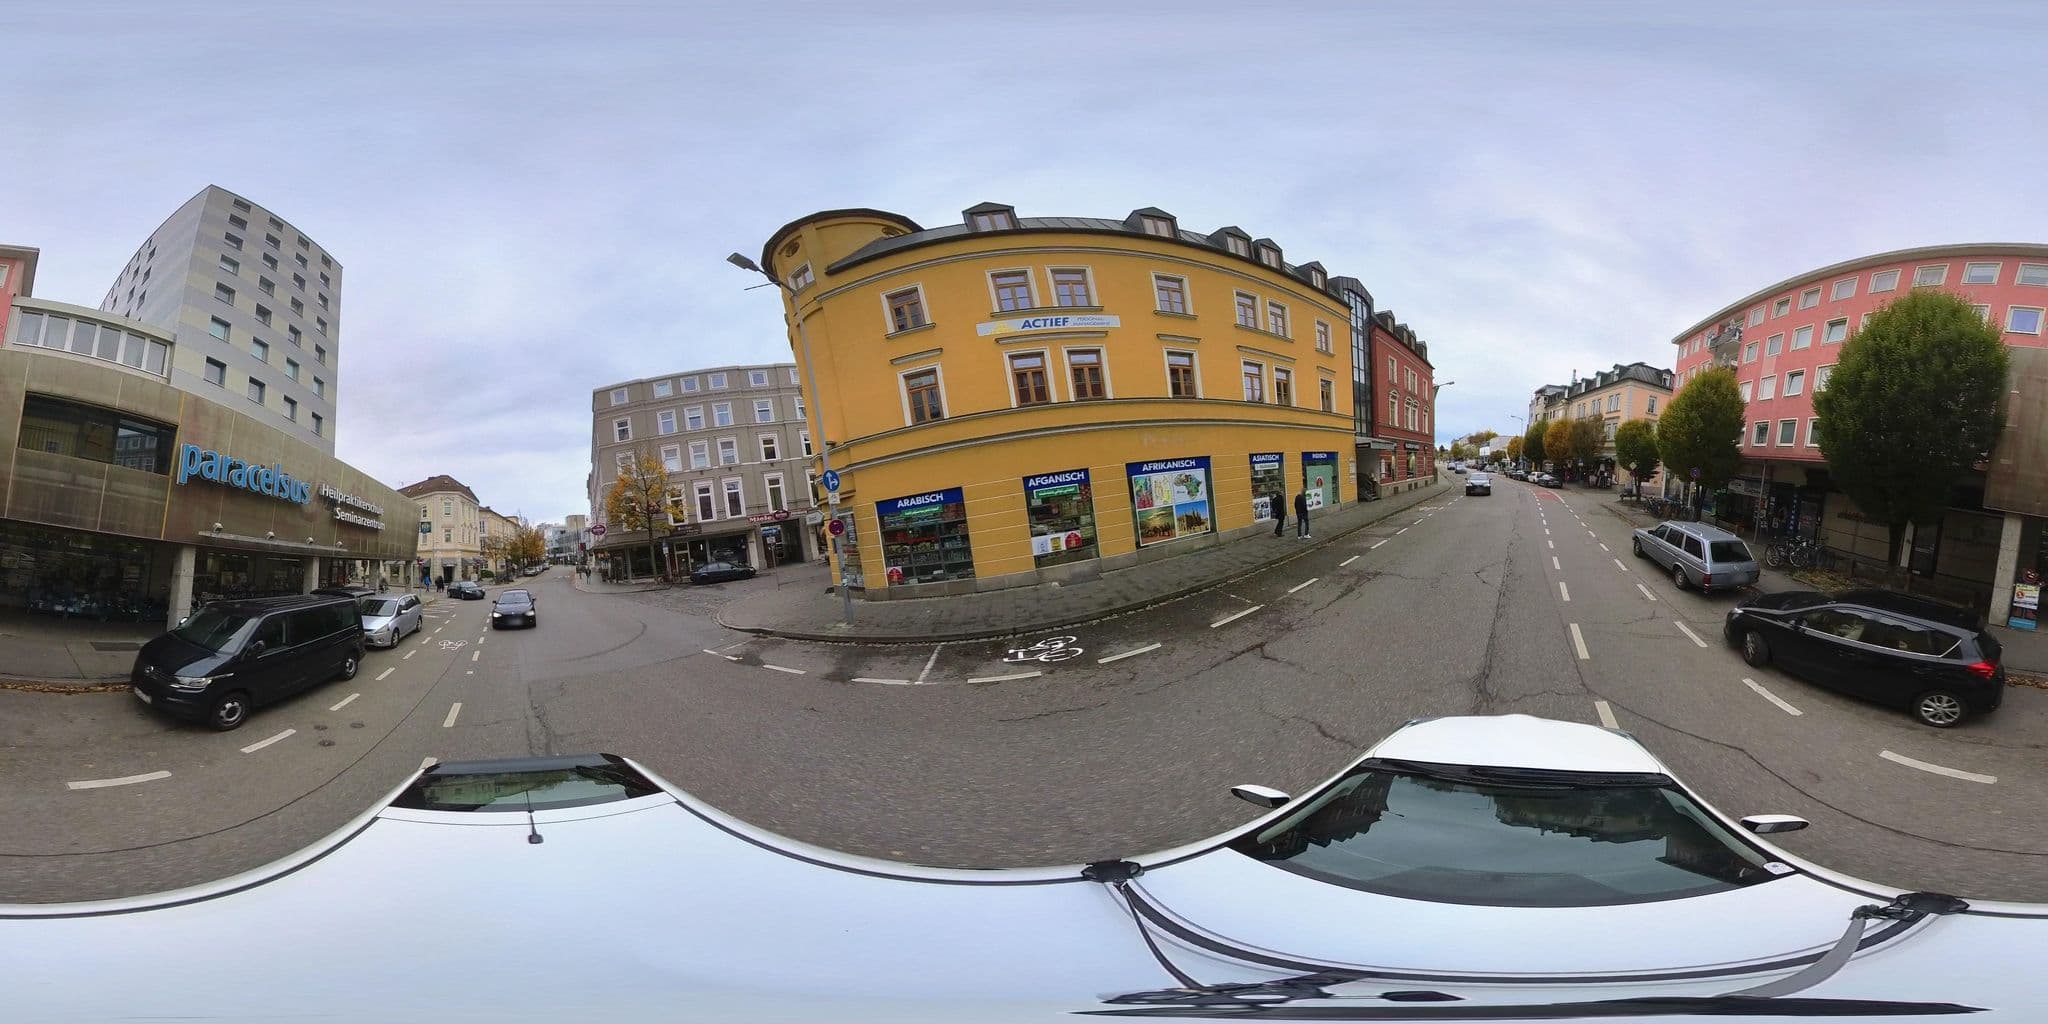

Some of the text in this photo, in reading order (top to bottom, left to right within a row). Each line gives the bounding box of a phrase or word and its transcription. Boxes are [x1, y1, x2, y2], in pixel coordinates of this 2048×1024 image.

[1021, 317, 1069, 329] ACTIEF
[1142, 459, 1196, 471] AFRIKANISCH
[1252, 454, 1279, 462] ASIATISCH
[177, 443, 311, 504] paracelsus
[1028, 472, 1085, 487] AFGANISCH
[321, 483, 384, 516] Heilpraktikerschule
[897, 493, 944, 508] ARABISCH
[335, 507, 385, 531] Seminarzentrum
